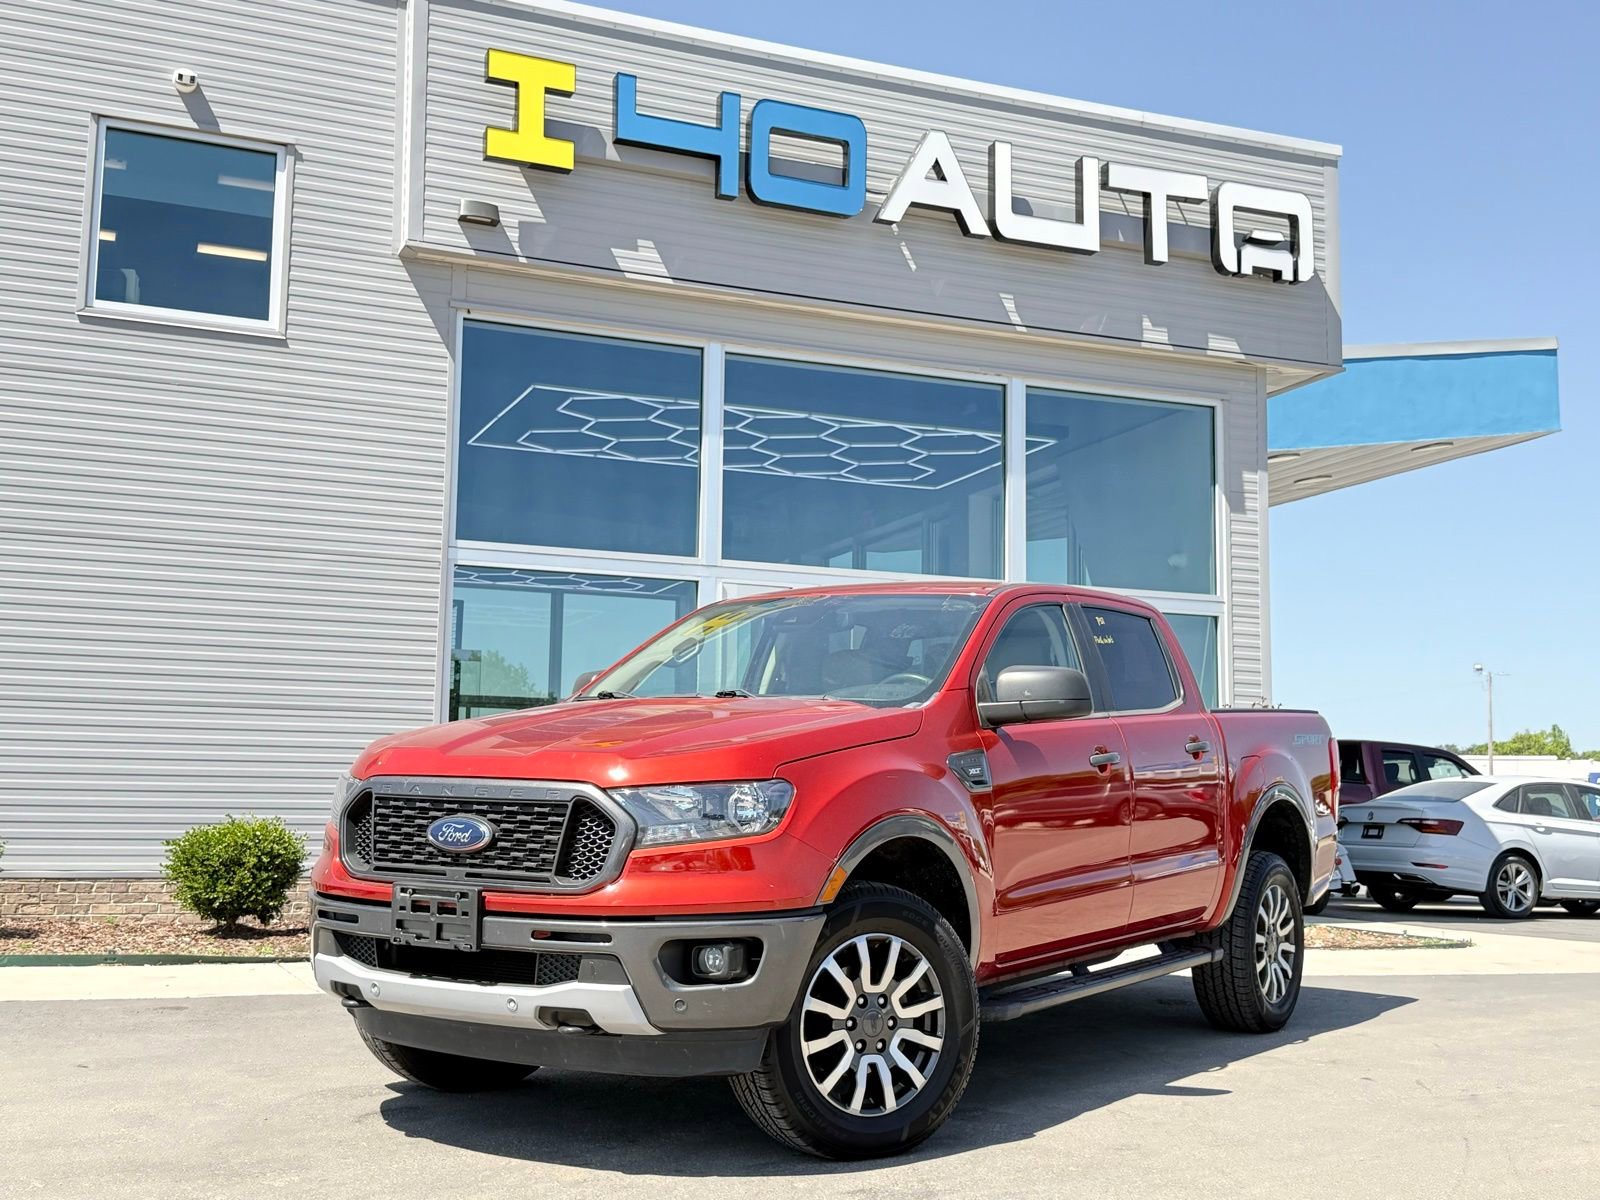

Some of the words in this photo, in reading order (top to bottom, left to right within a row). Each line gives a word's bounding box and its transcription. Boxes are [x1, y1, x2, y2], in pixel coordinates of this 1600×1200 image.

[484, 47, 577, 175] I
[613, 71, 868, 220] 40
[873, 128, 1316, 286] AUTO
[379, 783, 562, 800] RANGER
[437, 822, 473, 843] Ford
